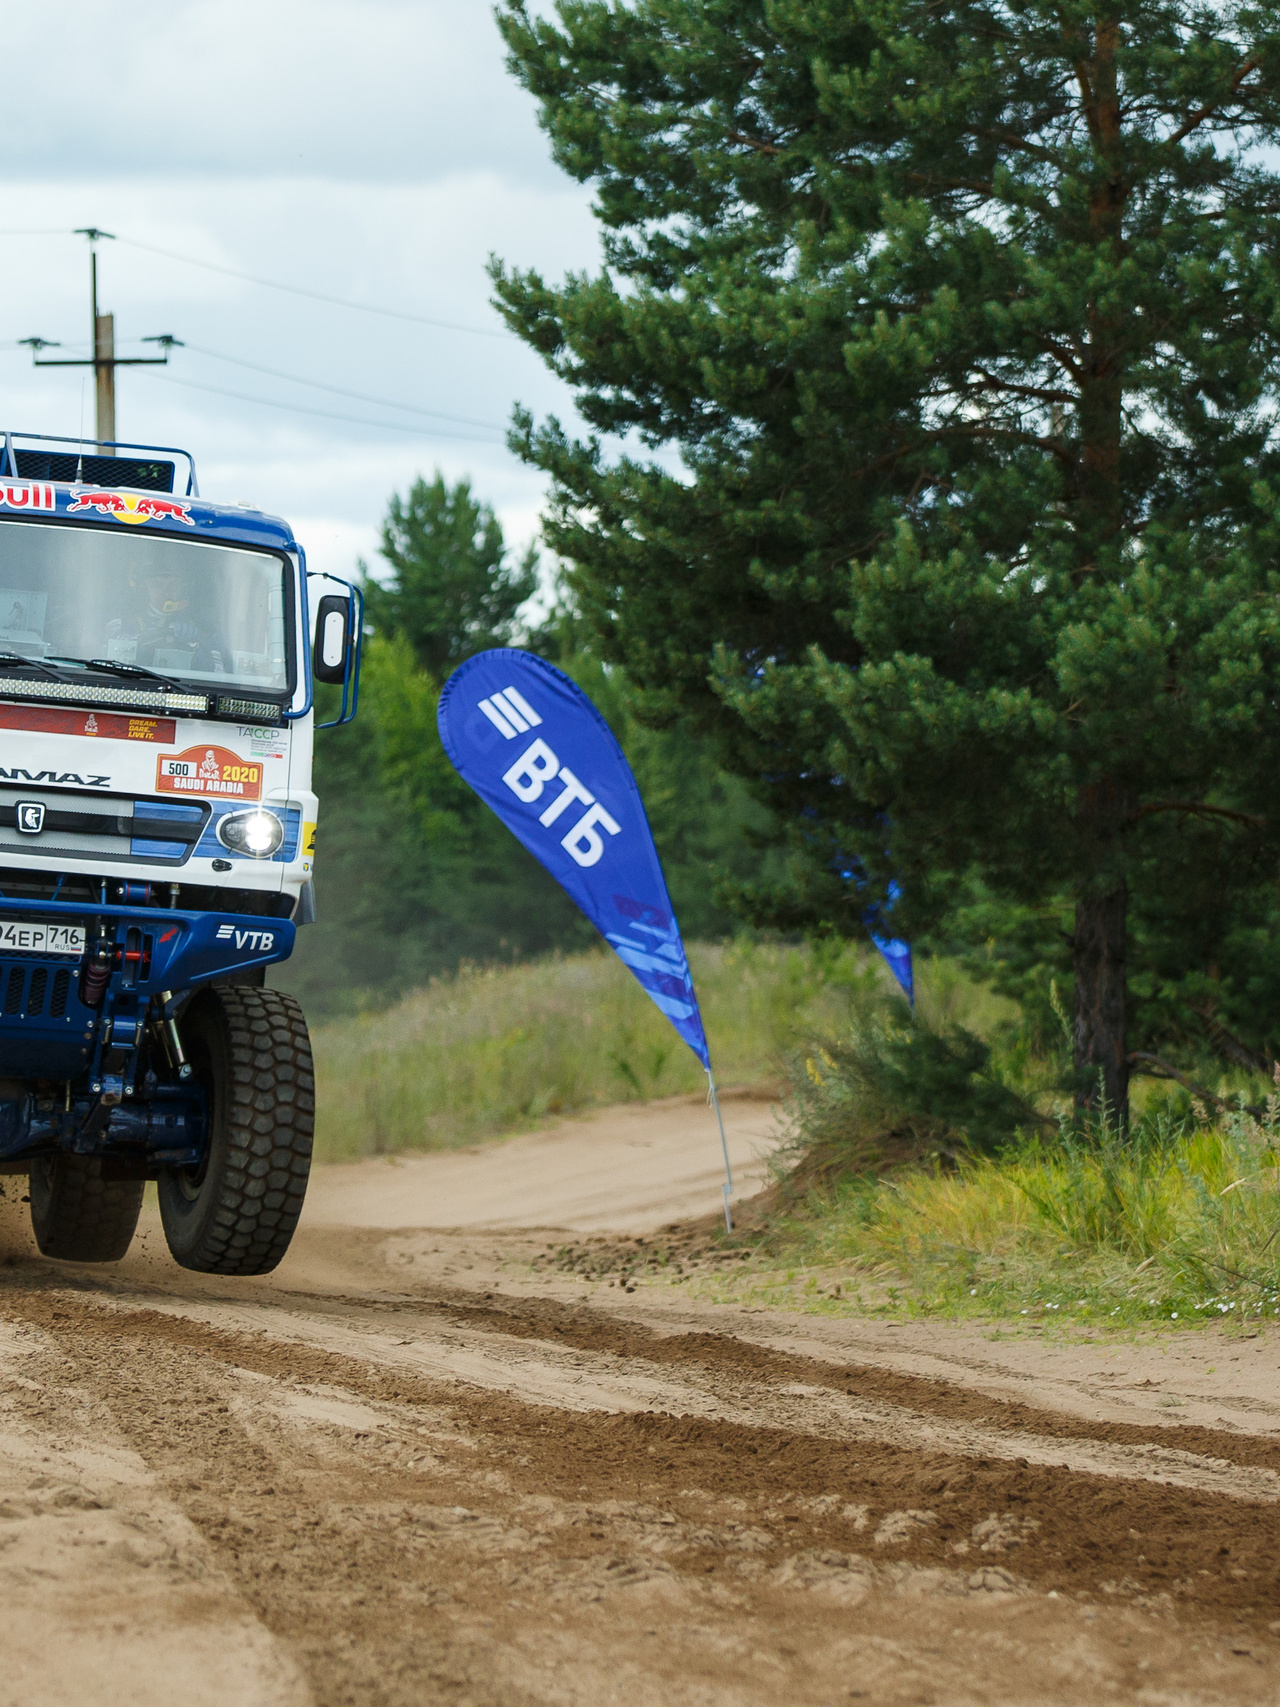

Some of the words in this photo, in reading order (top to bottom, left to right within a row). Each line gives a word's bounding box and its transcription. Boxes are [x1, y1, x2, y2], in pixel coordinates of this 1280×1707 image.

[128, 731, 145, 739] LIVE
[168, 762, 189, 776] 500
[222, 765, 259, 783] 2020
[173, 777, 205, 791] SAUDI
[206, 779, 244, 795] ARABIA
[502, 737, 622, 868] ВТБ
[48, 927, 80, 945] 716
[234, 931, 275, 951] VTB
[54, 943, 70, 951] RUS
